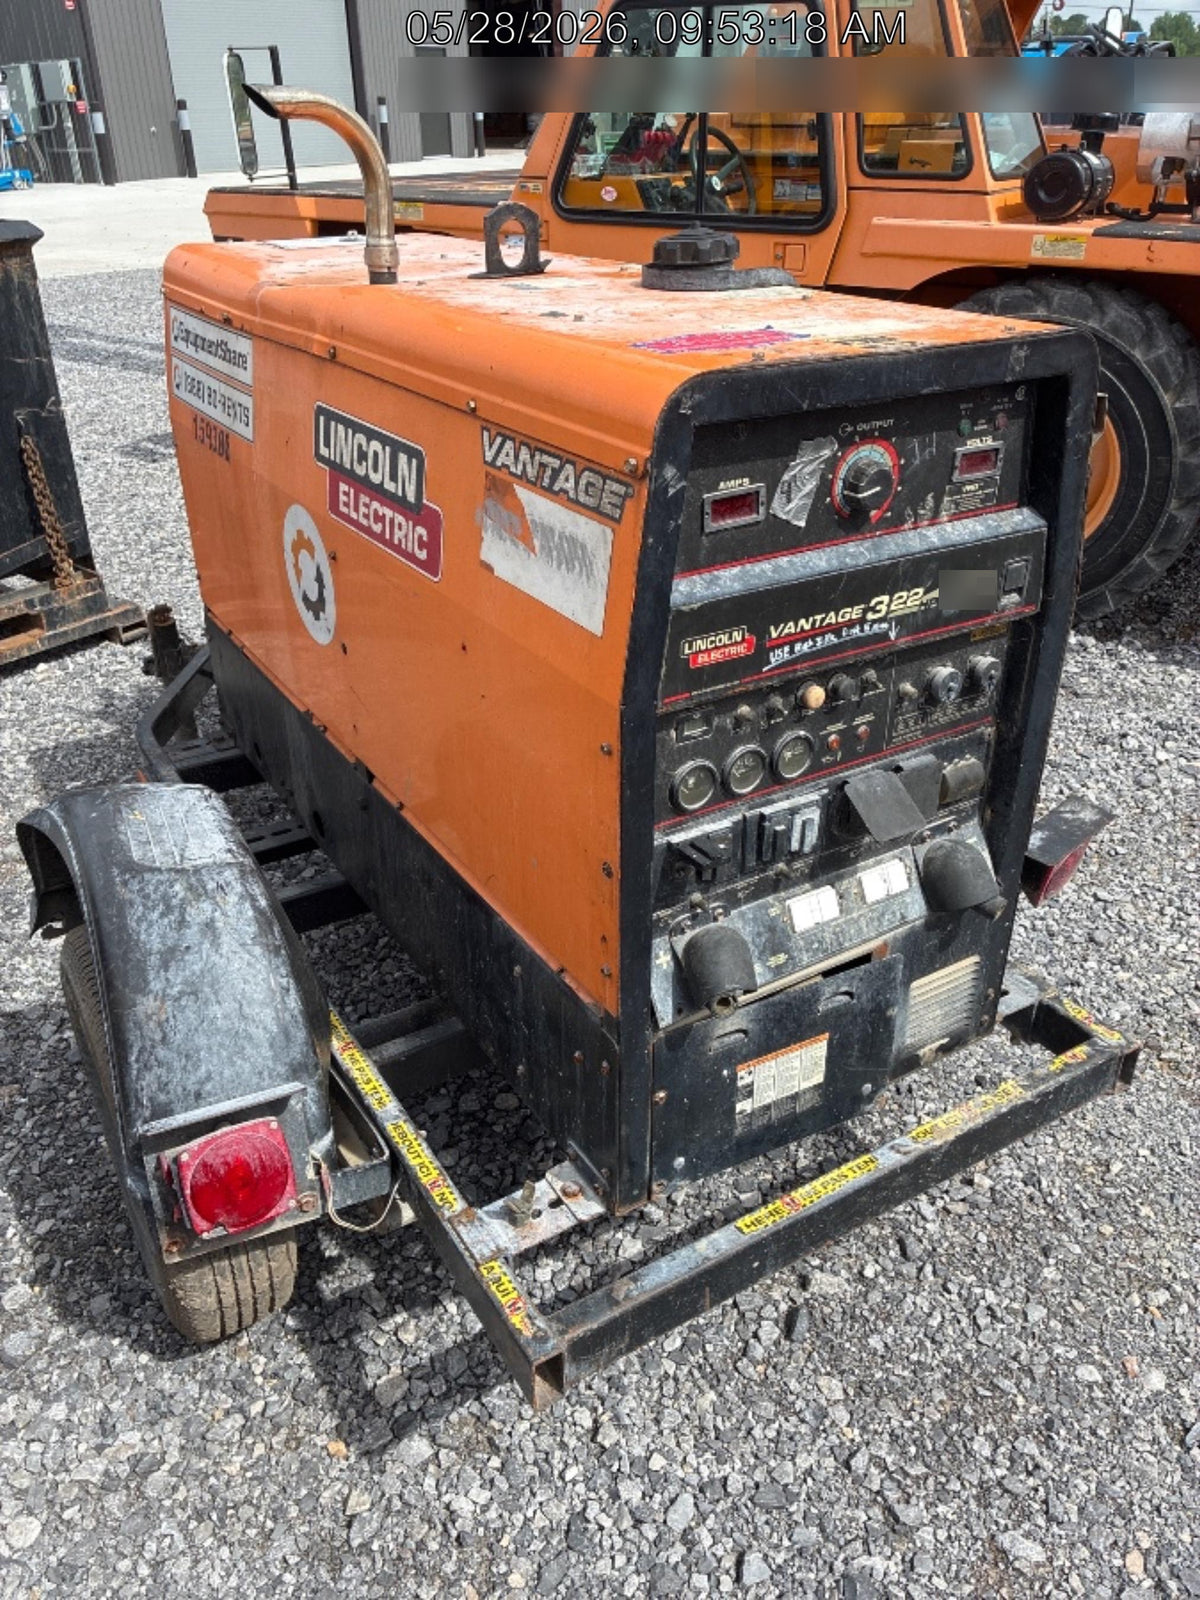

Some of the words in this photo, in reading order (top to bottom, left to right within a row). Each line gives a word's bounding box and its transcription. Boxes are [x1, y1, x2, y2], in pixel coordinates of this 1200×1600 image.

[856, 418, 895, 432] OUTPUT
[318, 414, 418, 504] LINCOLN
[482, 427, 628, 523] VANTAGE
[718, 477, 750, 490] AMPS
[338, 481, 428, 561] ELECTRIC
[769, 604, 866, 639] VANTAGE
[865, 587, 925, 621] 322
[684, 629, 743, 655] LINCOLN
[698, 642, 748, 664] ELECTRIC
